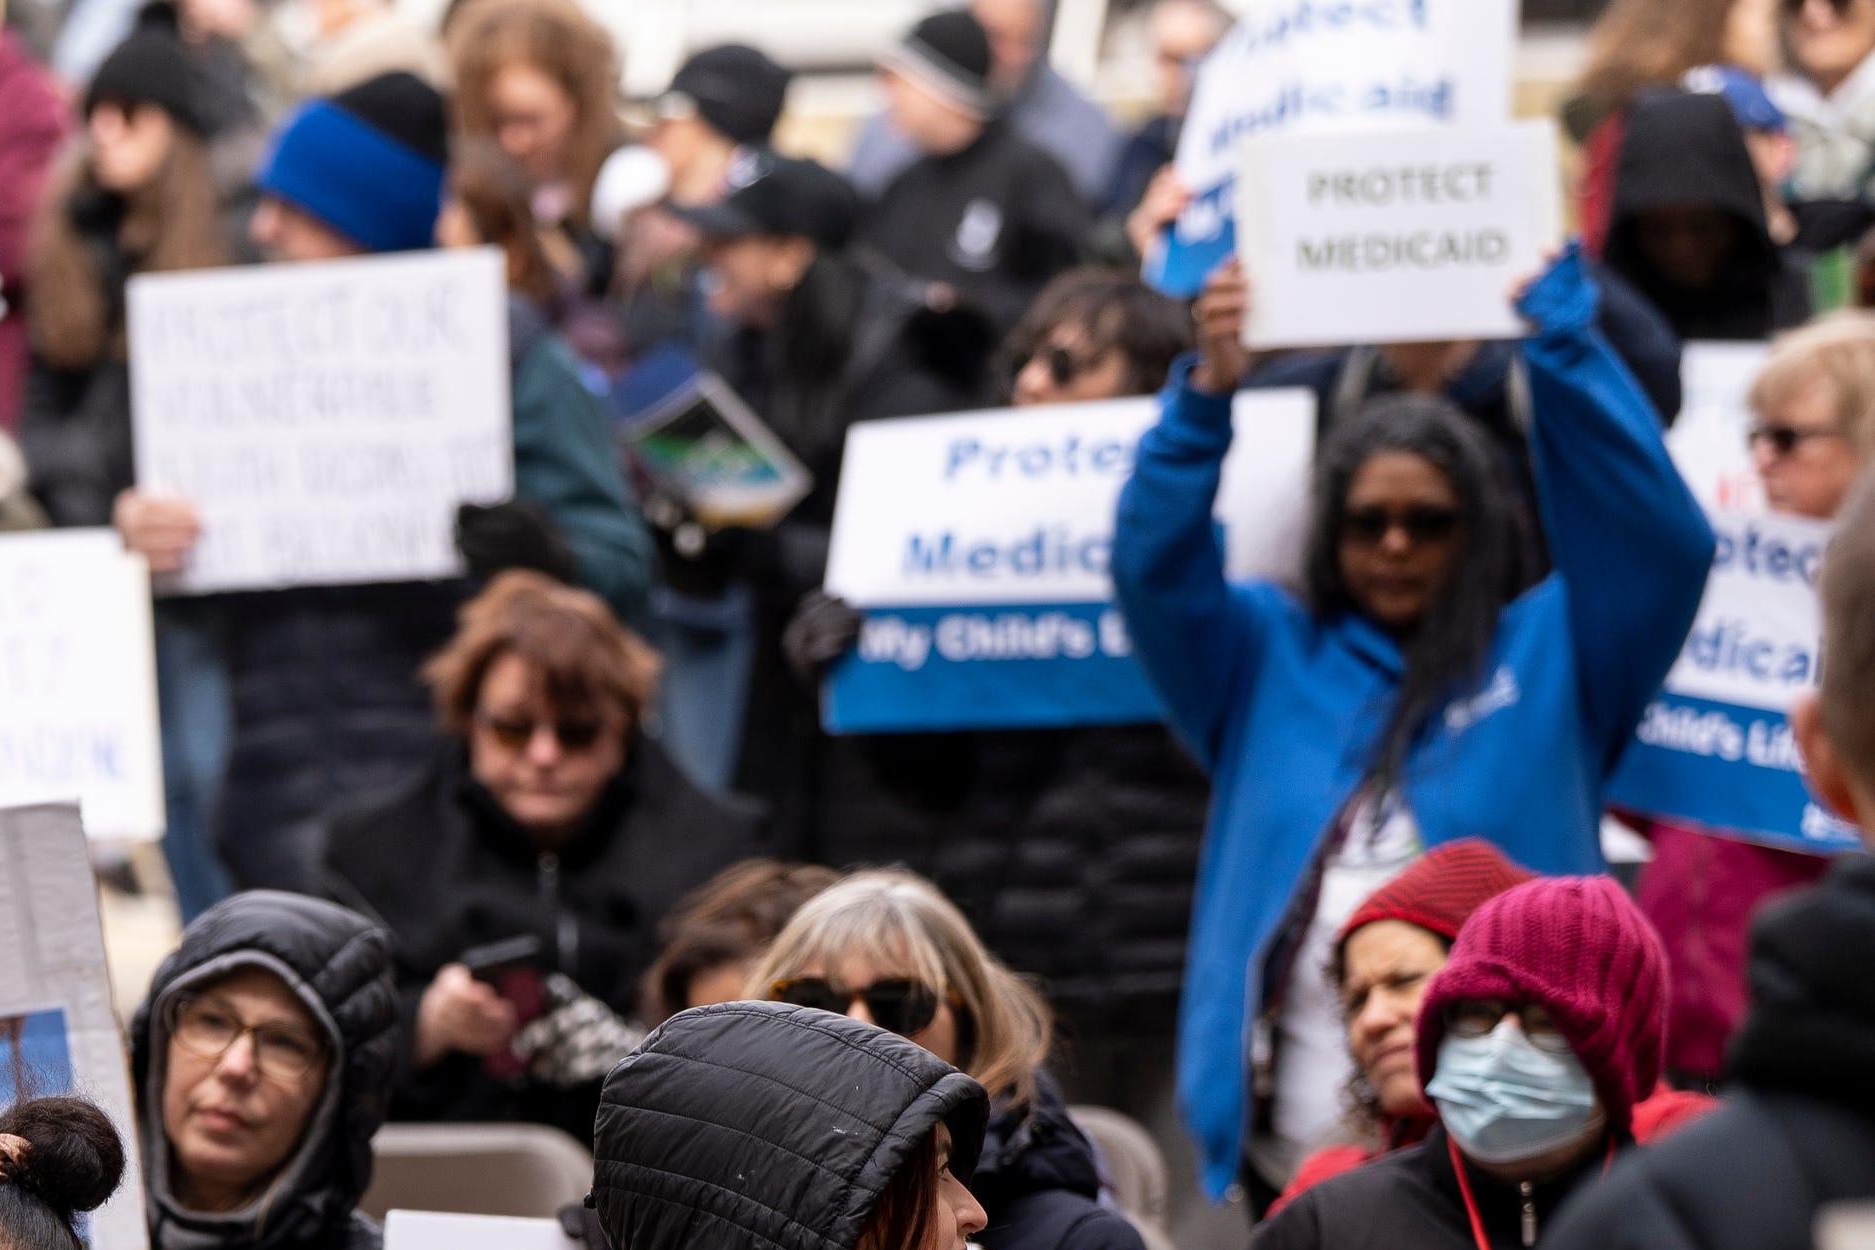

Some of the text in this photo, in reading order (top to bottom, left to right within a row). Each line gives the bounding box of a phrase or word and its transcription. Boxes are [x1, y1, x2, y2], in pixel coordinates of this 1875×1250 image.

[1305, 162, 1496, 207] PROTECT
[1297, 227, 1510, 274] MEDICAID
[943, 436, 1135, 480] Prote
[902, 526, 1115, 579] Medic
[933, 611, 1097, 663] Child's
